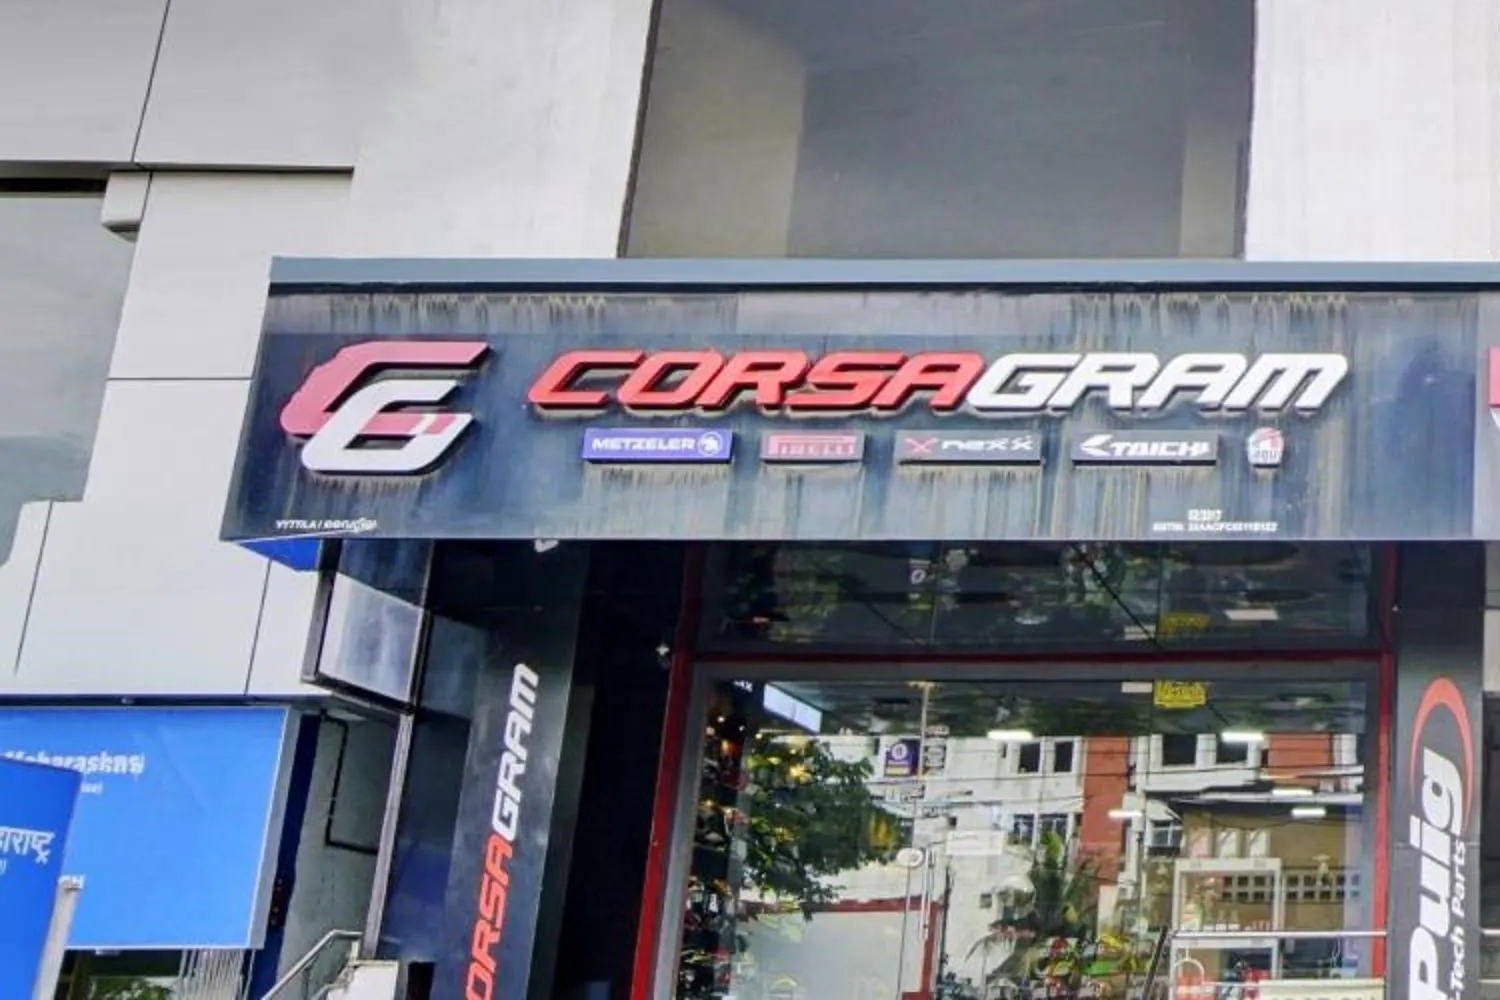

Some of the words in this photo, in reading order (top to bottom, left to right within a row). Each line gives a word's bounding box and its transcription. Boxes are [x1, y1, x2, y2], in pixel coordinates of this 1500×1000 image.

[528, 350, 1348, 411] CORSAGRAM
[592, 437, 695, 451] METZELER
[466, 663, 539, 1000] ORSAGRAM
[1450, 841, 1467, 917] Parts
